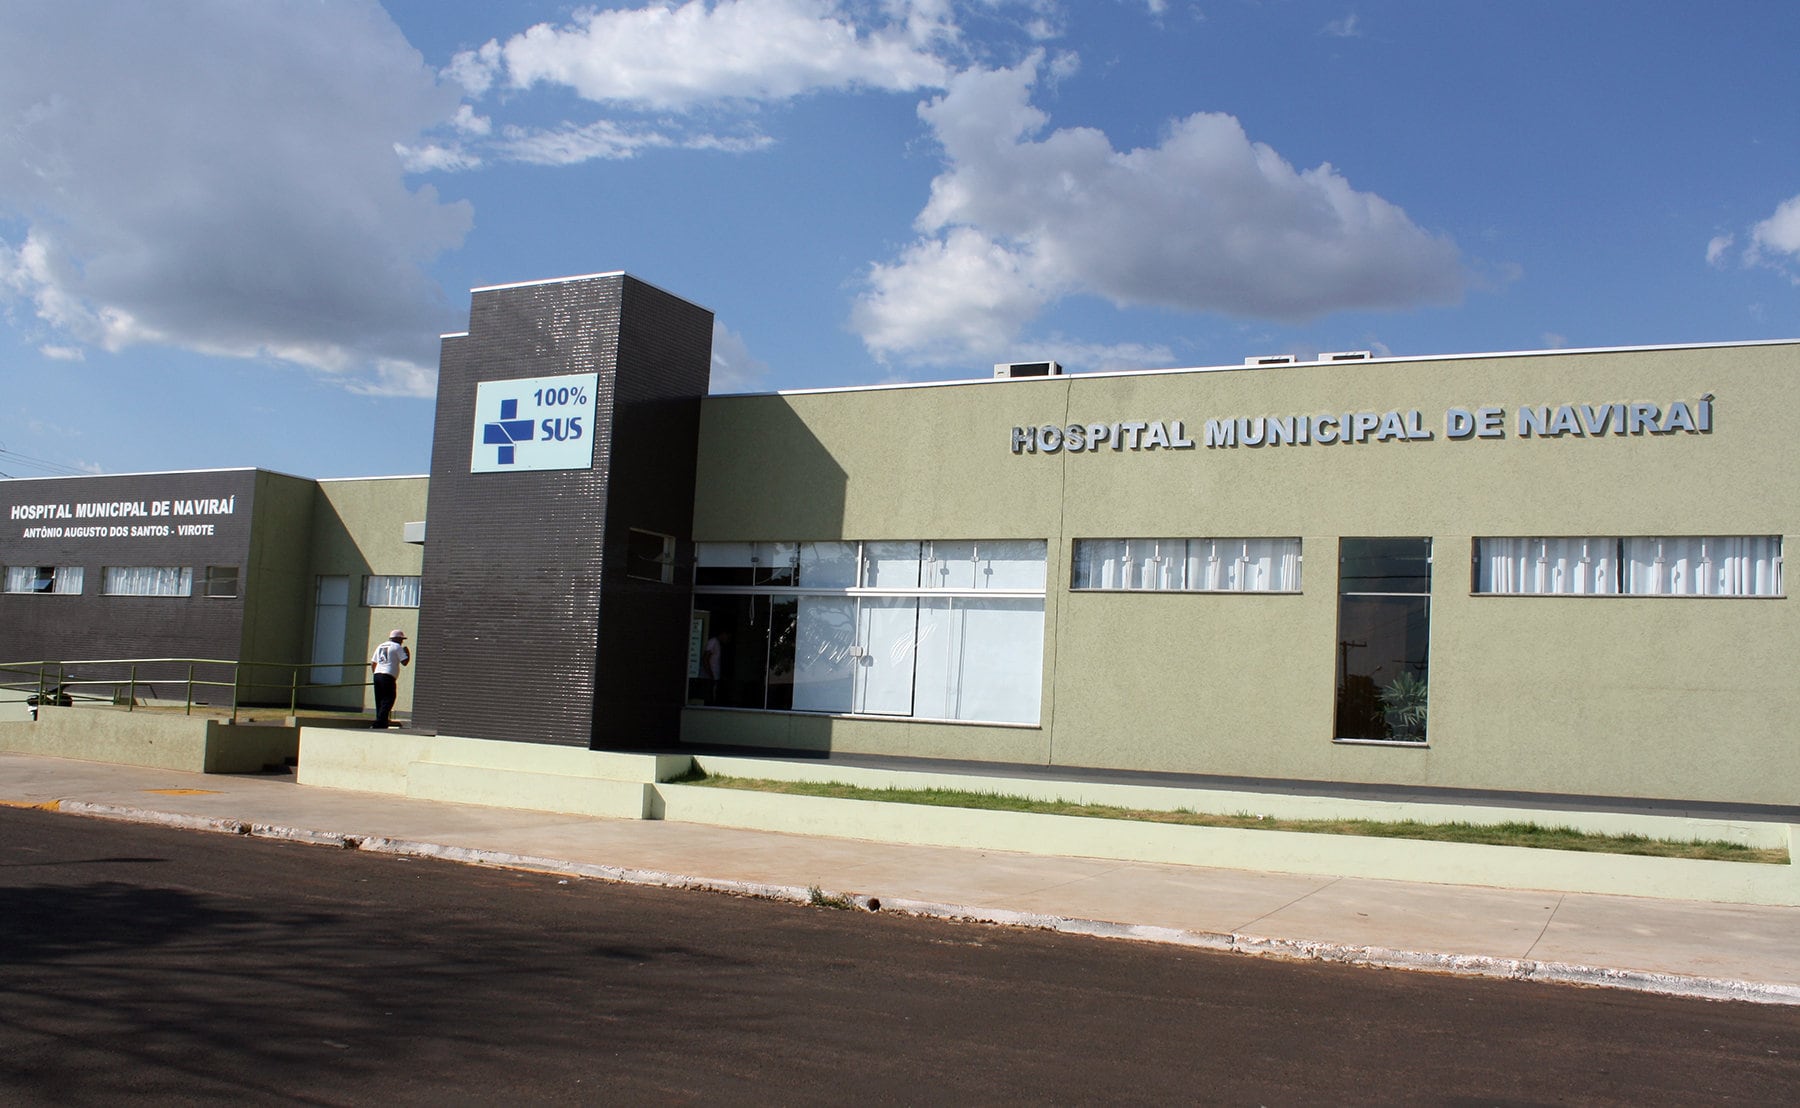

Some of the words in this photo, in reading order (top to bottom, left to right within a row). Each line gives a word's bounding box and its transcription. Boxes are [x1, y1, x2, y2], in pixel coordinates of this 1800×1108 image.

[534, 386, 587, 406] 100%
[541, 417, 583, 441] SUS
[1011, 421, 1195, 452] HOSPITAL
[1205, 409, 1433, 447] MUNICIPAL
[1446, 406, 1504, 441] DE
[1518, 392, 1715, 438] NAVIRAÍ
[11, 504, 73, 520] HOSPITAL
[75, 501, 148, 518] MUNICIPAL
[151, 501, 170, 516] DE
[173, 494, 235, 515] NAVIRAÍ
[64, 527, 107, 538] AUGUSTO
[110, 526, 129, 538] DOS
[130, 525, 169, 537] SANTOS
[178, 524, 215, 536] VIROTE
